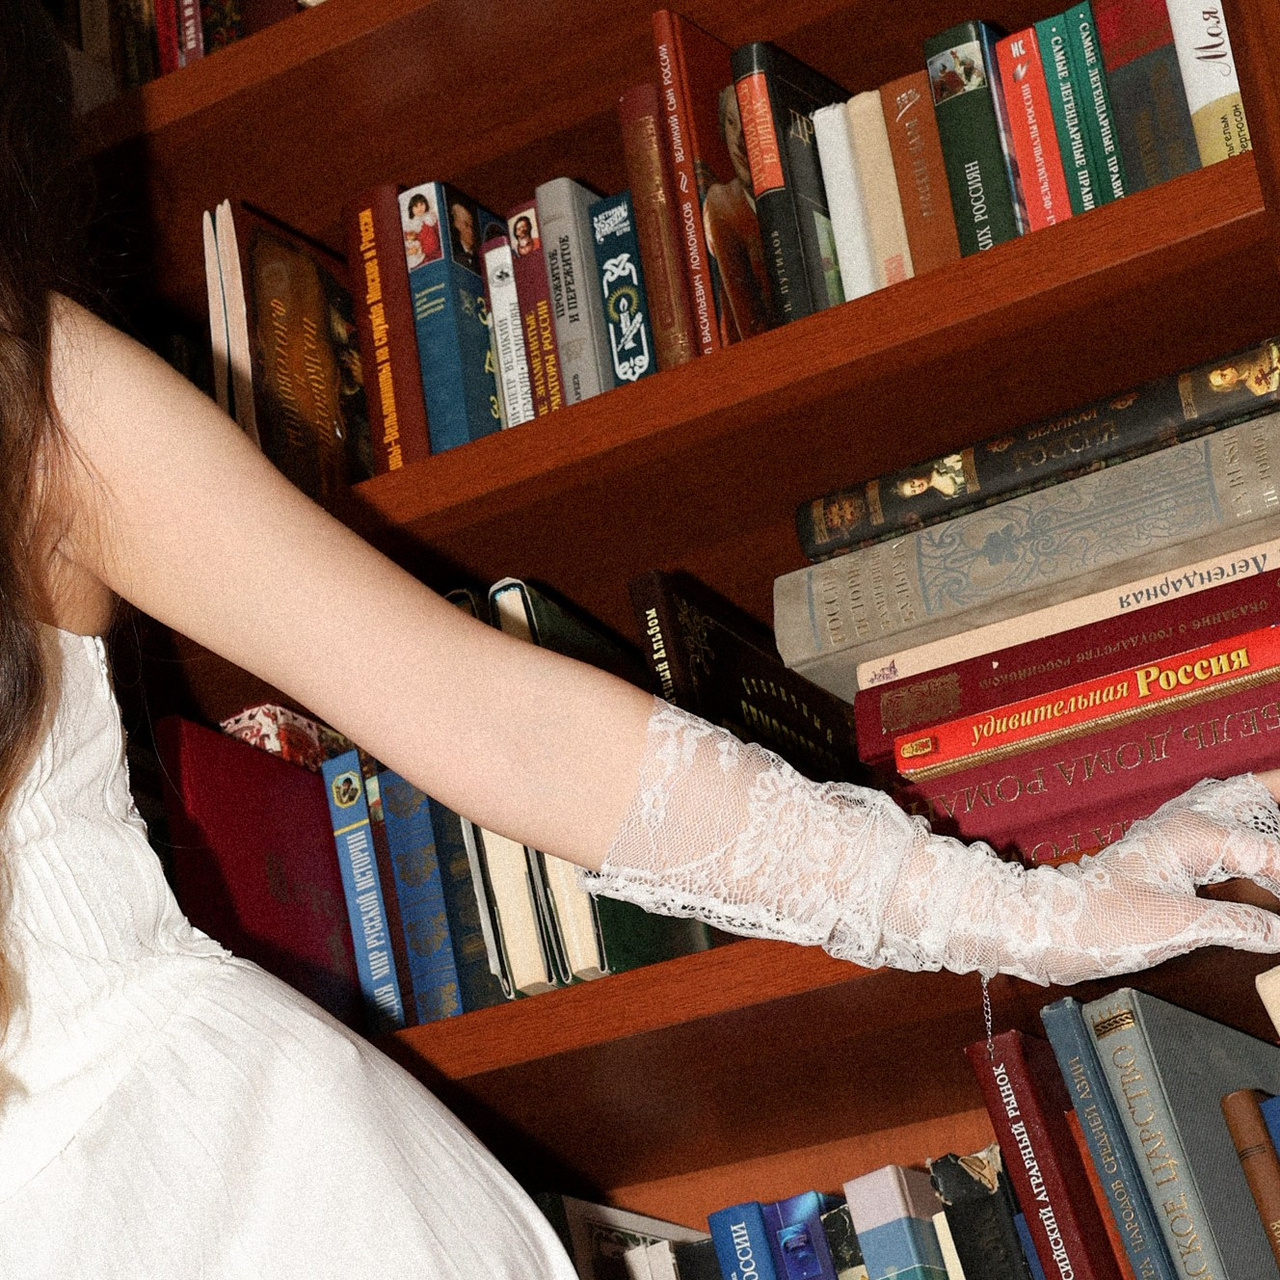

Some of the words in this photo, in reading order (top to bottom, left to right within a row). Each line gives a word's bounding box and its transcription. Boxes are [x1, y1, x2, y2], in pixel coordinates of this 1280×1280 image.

[659, 44, 672, 85] РОССИИ
[1051, 36, 1068, 79] САМЫЕ
[1187, 5, 1232, 80] Моя
[666, 88, 677, 111] СЫН
[1079, 22, 1095, 66] САМЫЕ
[1088, 68, 1114, 154] ЛЕГЕНДАРНЫЕ
[668, 114, 685, 163] ВЕЛИКИЙ
[1059, 81, 1086, 167] ЛЕГЕНДАРНЫЕ
[964, 160, 988, 222] РОССИЯН
[359, 209, 375, 251] России
[683, 202, 700, 270] ЛОМОНОСОВ
[365, 260, 381, 304] Москве
[548, 249, 565, 319] ПРОЖИТОЕ
[556, 235, 578, 310] ПЕРЕЖИТОЕ
[771, 230, 789, 294] ПУТИЛОВ
[369, 304, 389, 346] службе
[537, 300, 553, 350] РОССИИ
[569, 313, 579, 323] И
[694, 274, 712, 343] ВАСИЛЬЕВИЧ
[526, 311, 545, 396] ЗНАМЕНИТЫЕ
[1114, 548, 1272, 612] Легендарная
[646, 608, 666, 659] Альбом
[972, 682, 1127, 746] удивительная
[1136, 649, 1249, 697] Россия
[1053, 726, 1171, 786] ДОМА
[346, 830, 375, 891] ИСТОРИИ
[357, 890, 385, 949] РУССКОЙ
[368, 951, 389, 980] МИР
[993, 1063, 1020, 1118] РЫНОК
[1068, 1056, 1092, 1099] АЗИИ
[1085, 1104, 1117, 1174] СРЕДНЕЙ
[1108, 1039, 1183, 1189] ЦАРСТВО
[1011, 1121, 1049, 1202] АГРАРНЫЙ
[1110, 1179, 1143, 1253] НАРОДОВ
